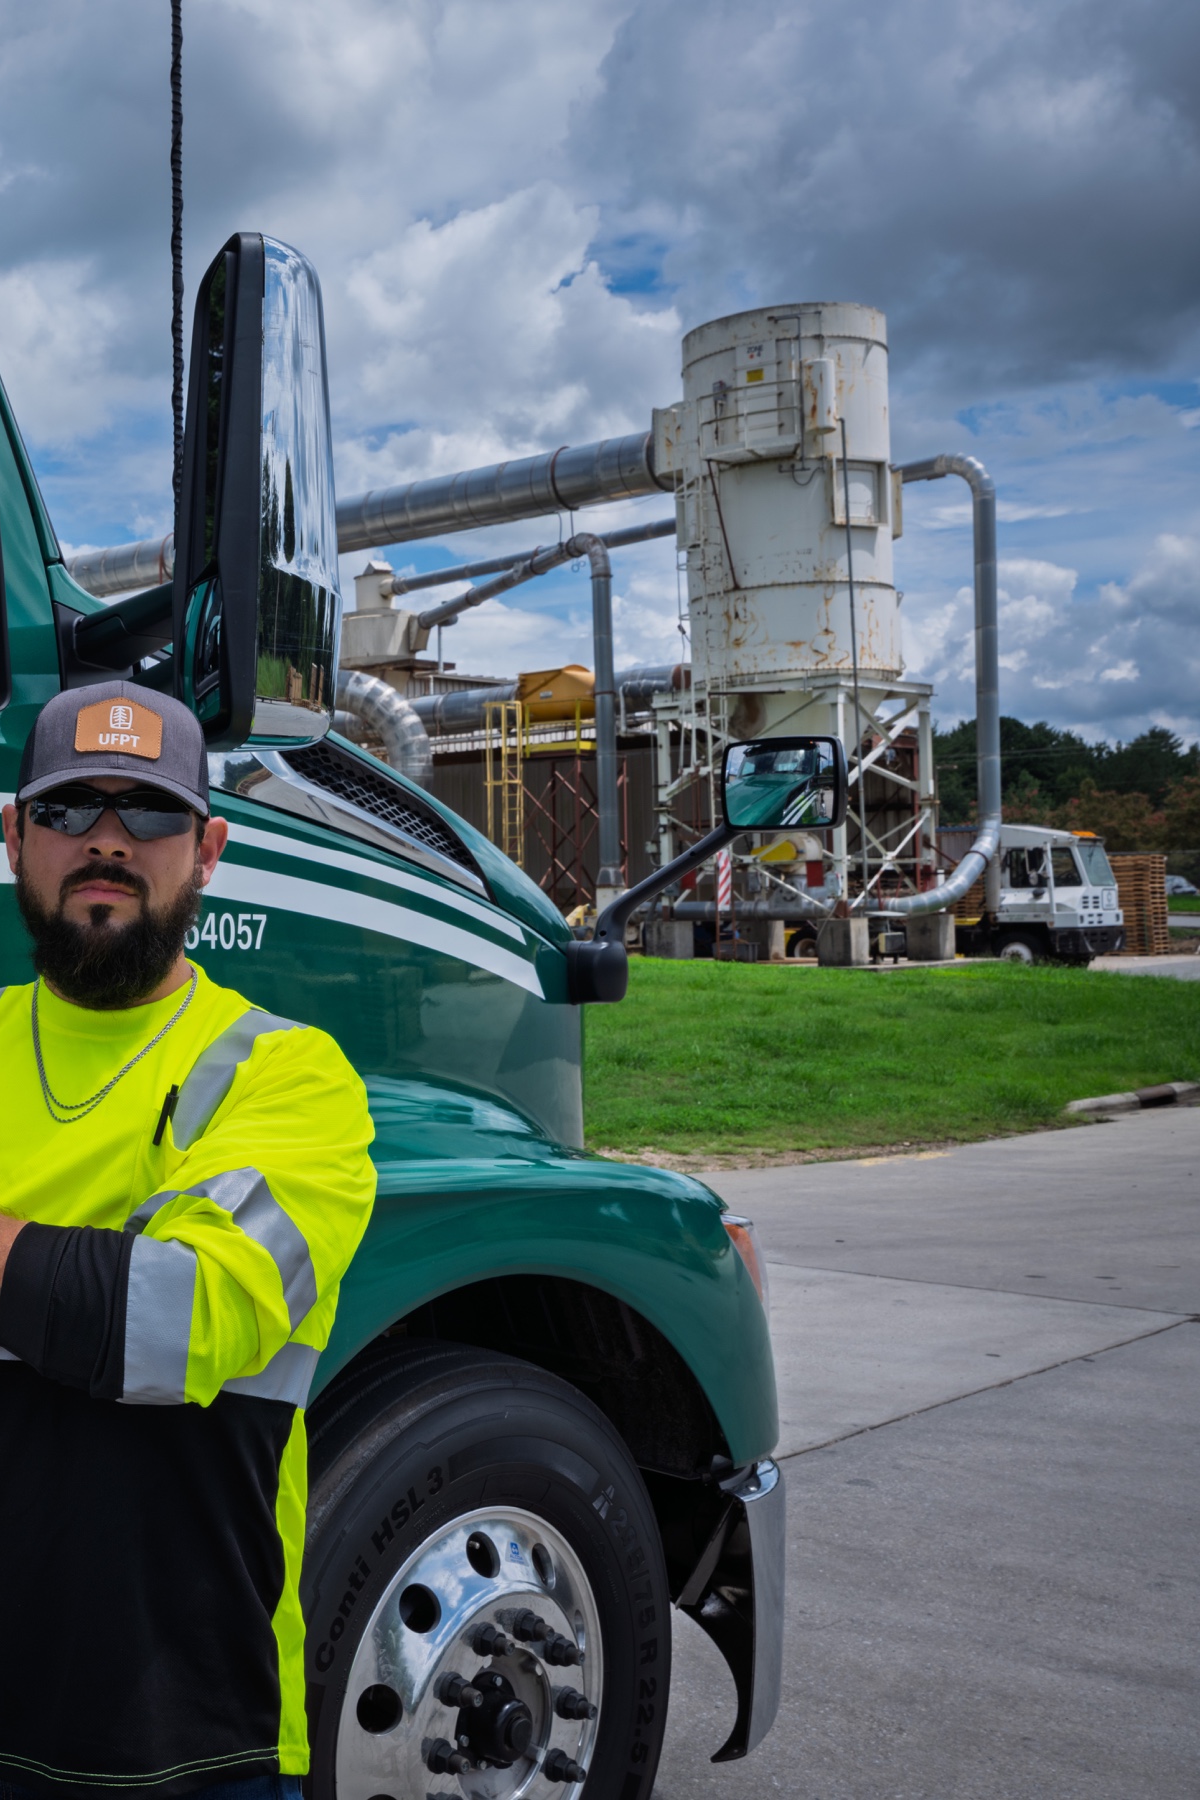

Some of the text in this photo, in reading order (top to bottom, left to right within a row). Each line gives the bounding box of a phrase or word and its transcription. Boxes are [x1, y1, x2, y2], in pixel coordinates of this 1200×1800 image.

[98, 733, 141, 748] UFPT
[315, 1555, 372, 1673] Conti
[371, 1486, 425, 1556] HSL
[427, 1465, 443, 1496] 3
